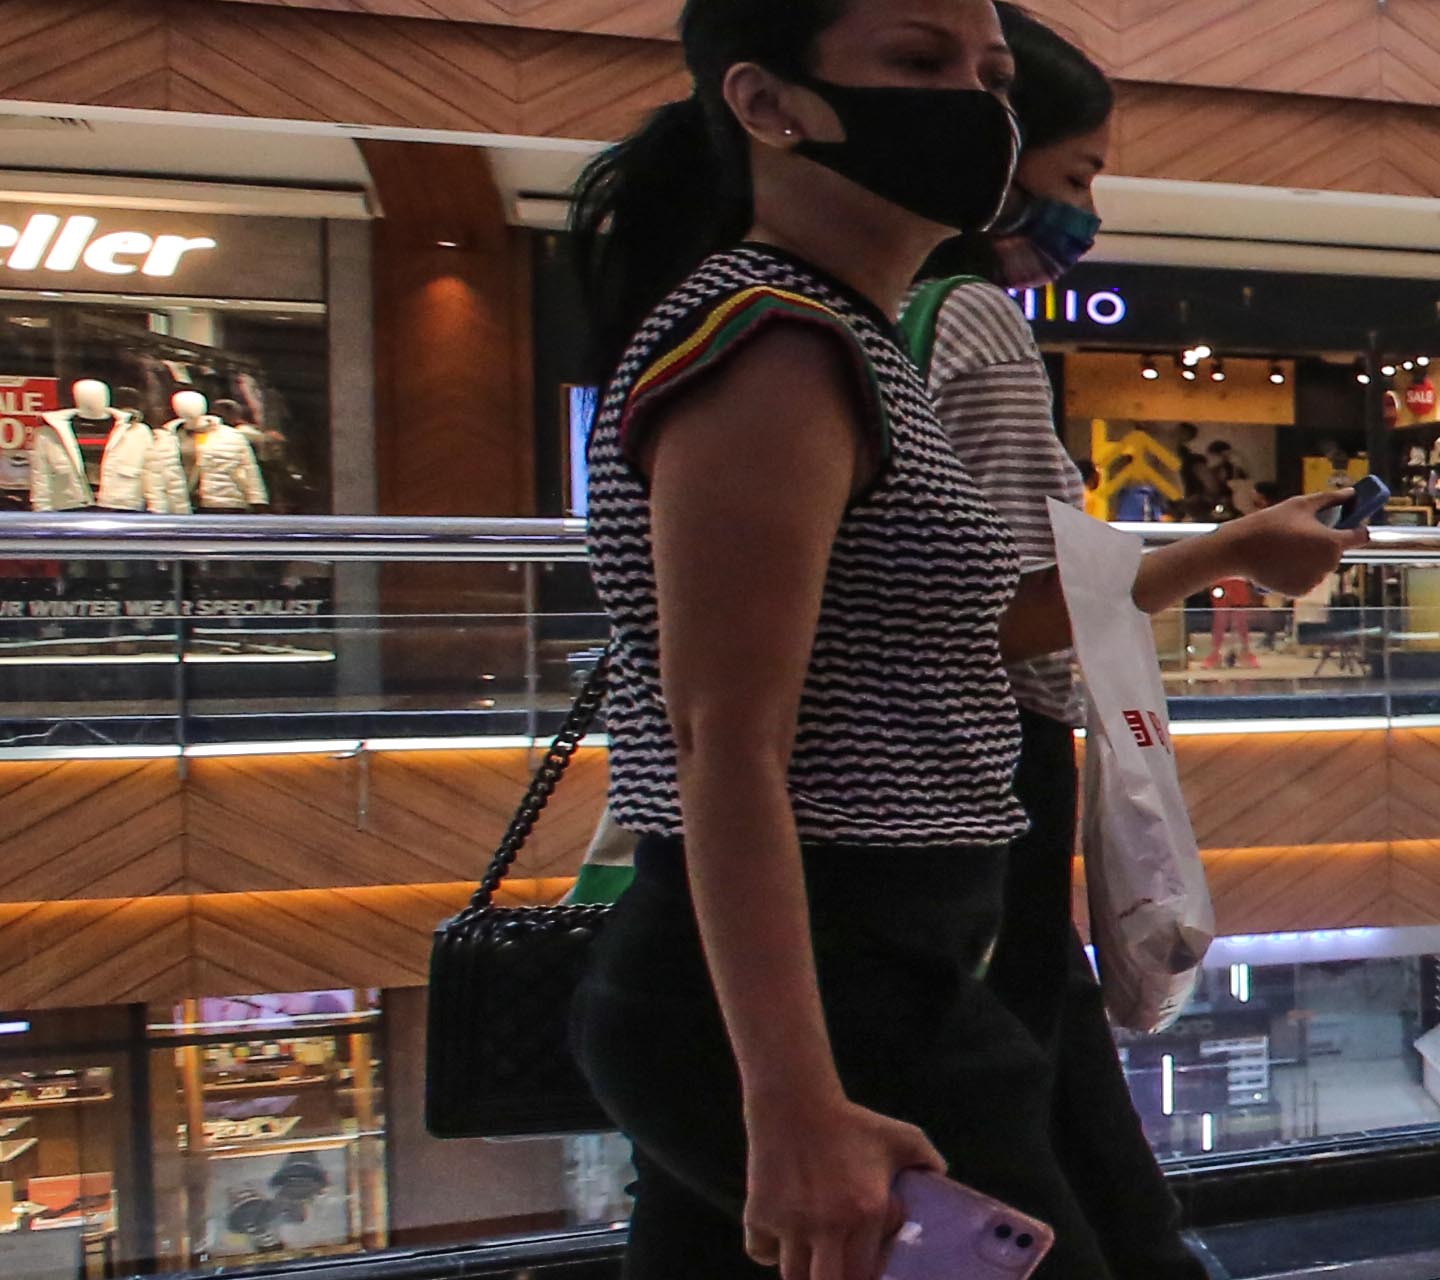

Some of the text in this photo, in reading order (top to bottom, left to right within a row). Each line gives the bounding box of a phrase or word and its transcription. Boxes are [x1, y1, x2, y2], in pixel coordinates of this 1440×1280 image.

[1406, 389, 1434, 404] SALE
[28, 600, 120, 617] WINTER
[195, 599, 324, 616] SPECIALIST
